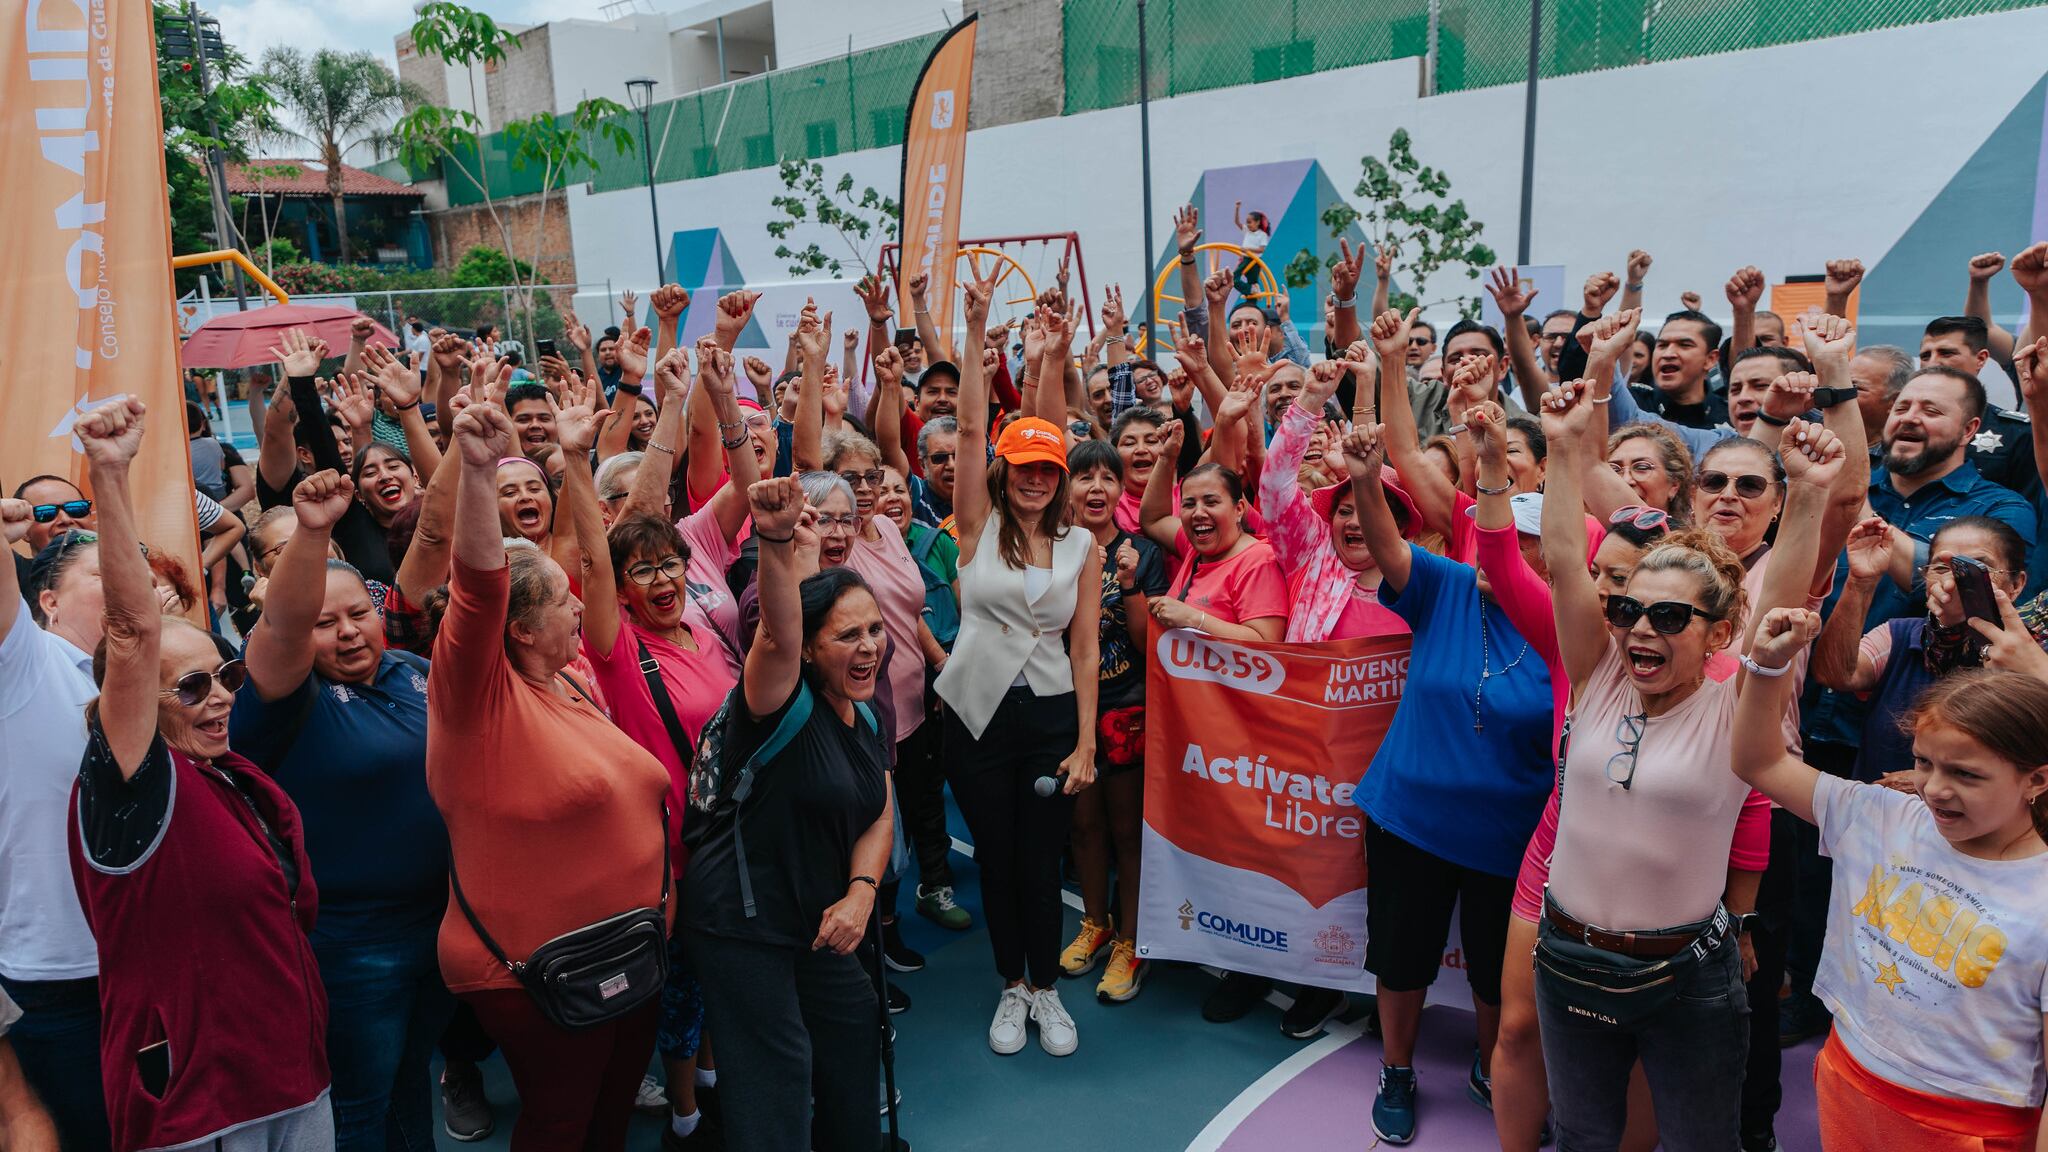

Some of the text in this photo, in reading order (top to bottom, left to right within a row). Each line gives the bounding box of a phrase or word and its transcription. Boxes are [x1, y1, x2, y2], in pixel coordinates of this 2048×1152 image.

[97, 46, 112, 72] de
[97, 287, 119, 359] Consejo
[1182, 742, 1361, 807] Actívate
[1265, 795, 1361, 839] Libre
[1900, 865, 1988, 915] MAKE SOMEONE SMILE
[1197, 911, 1288, 948] COMUDE
[1850, 863, 2009, 988] MAGIC
[1898, 954, 1930, 975] positive
[1929, 971, 1957, 990] change
[1567, 1005, 1592, 1018] BIMBA
[1598, 1013, 1618, 1025] LOLA
